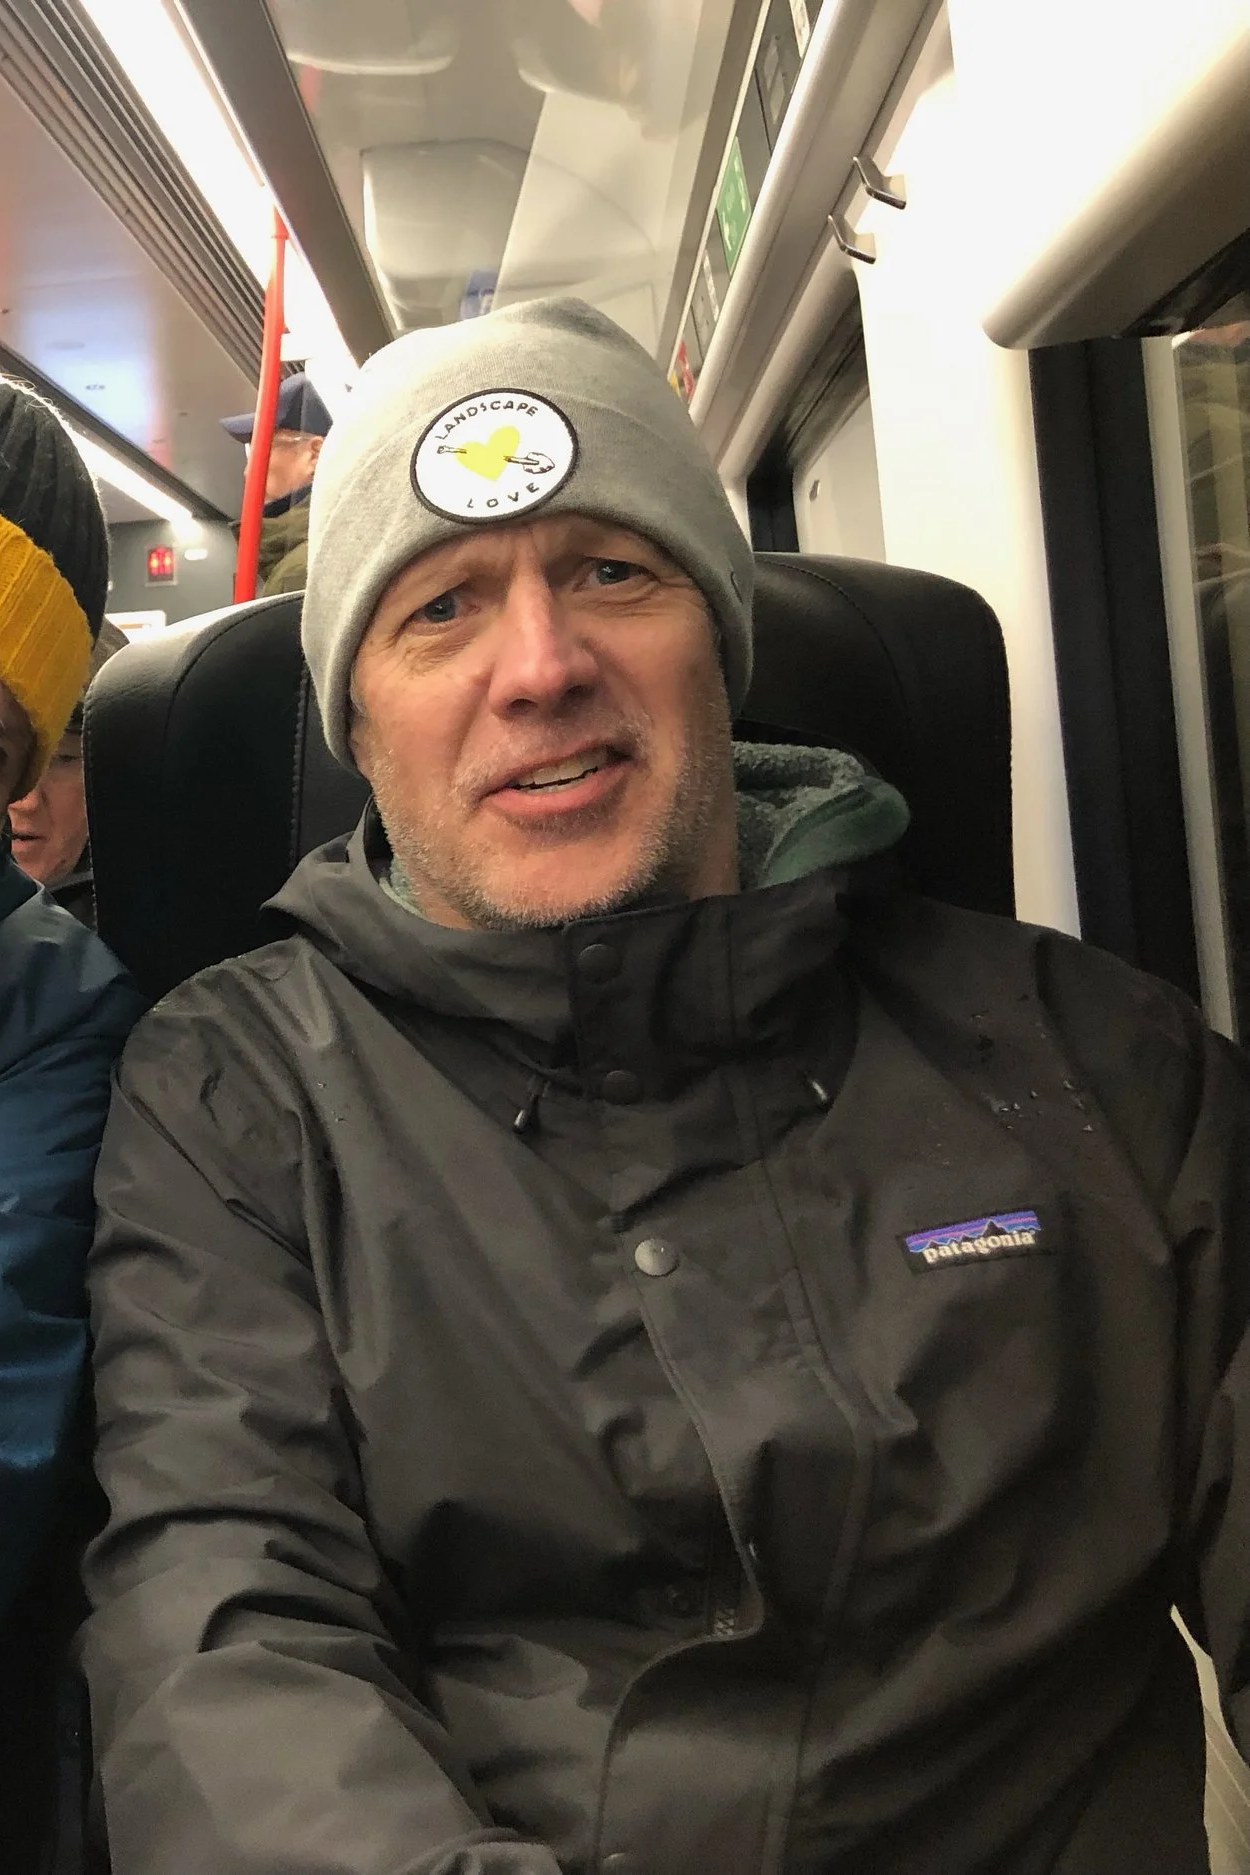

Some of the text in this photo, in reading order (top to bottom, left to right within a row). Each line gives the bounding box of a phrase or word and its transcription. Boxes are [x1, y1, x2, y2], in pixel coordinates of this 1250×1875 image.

[435, 400, 538, 440] LANDSCAPE
[466, 482, 540, 508] LOVE
[921, 1230, 1036, 1264] patagonia
